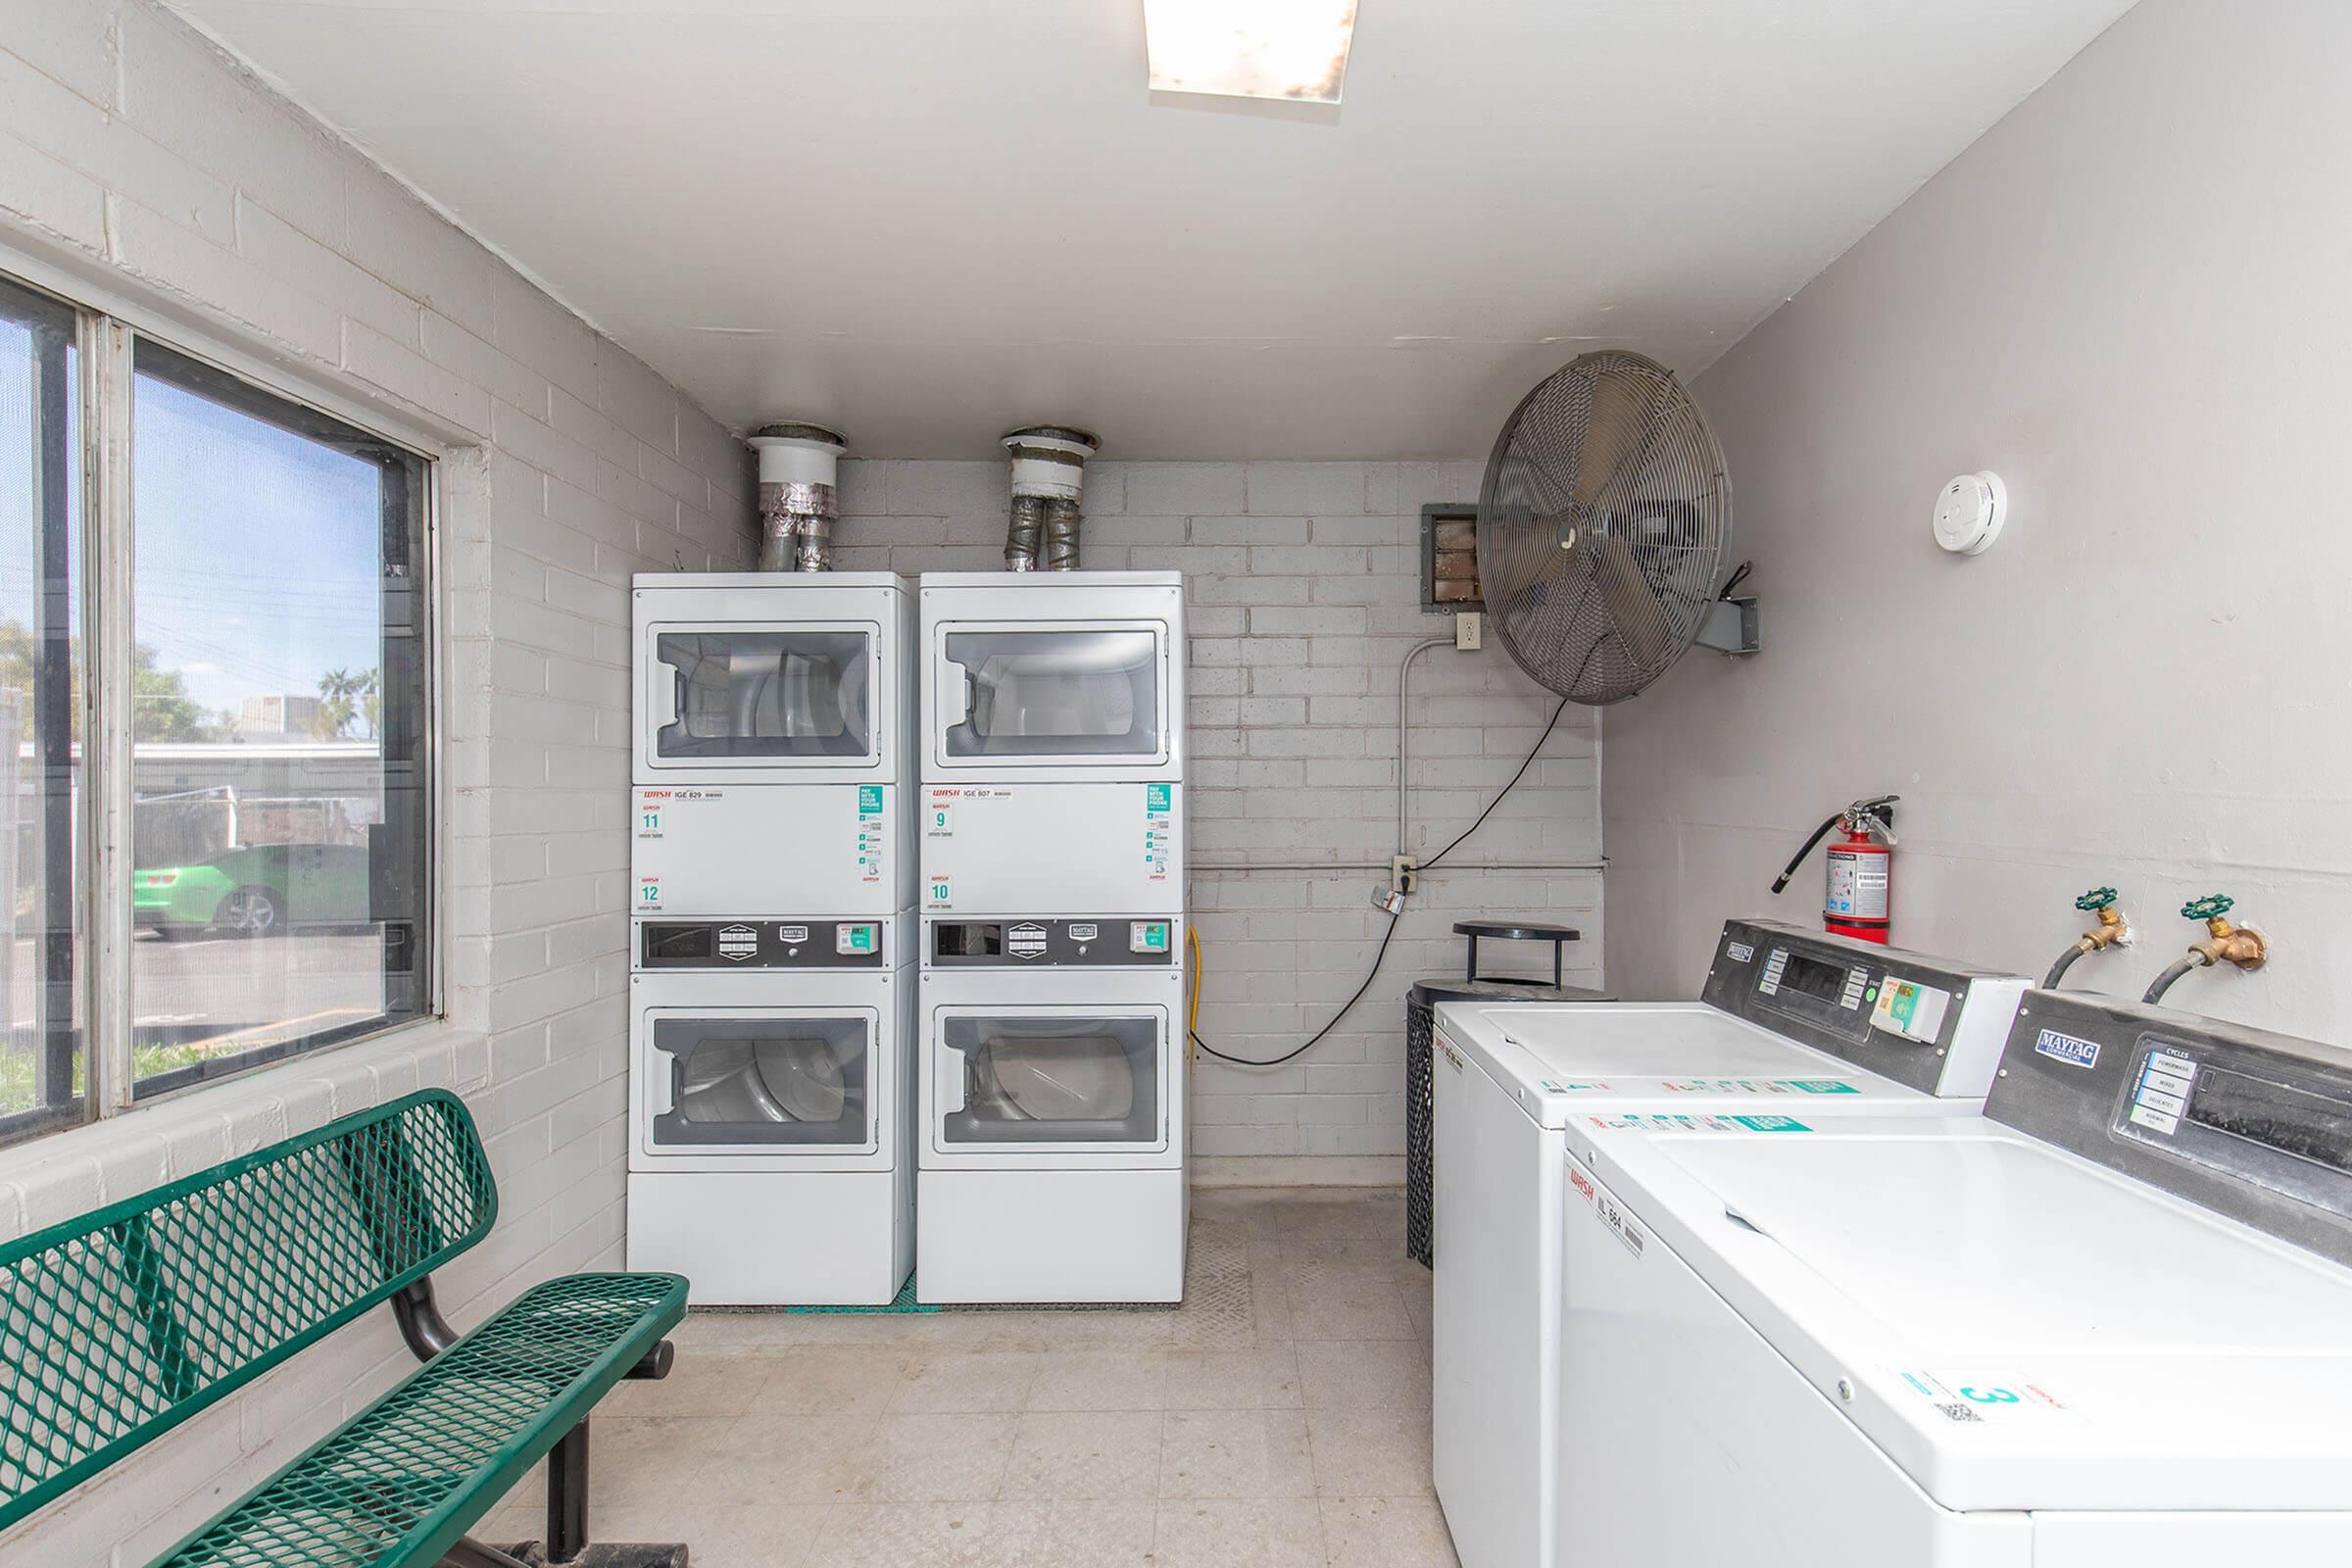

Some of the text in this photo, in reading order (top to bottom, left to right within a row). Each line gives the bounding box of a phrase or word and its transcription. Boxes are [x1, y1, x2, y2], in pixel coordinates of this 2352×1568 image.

[643, 814, 659, 828] 11
[936, 812, 946, 827] 9
[642, 886, 659, 901] 12
[932, 884, 948, 900] 10
[2040, 1033, 2094, 1059] MAYTAG
[2046, 1046, 2081, 1061] COMMERCIAL
[2166, 1048, 2189, 1058] CYCLES
[2148, 1097, 2174, 1108] DELICATES
[1570, 1168, 1595, 1200] WASH
[1959, 1387, 2021, 1404] 3
